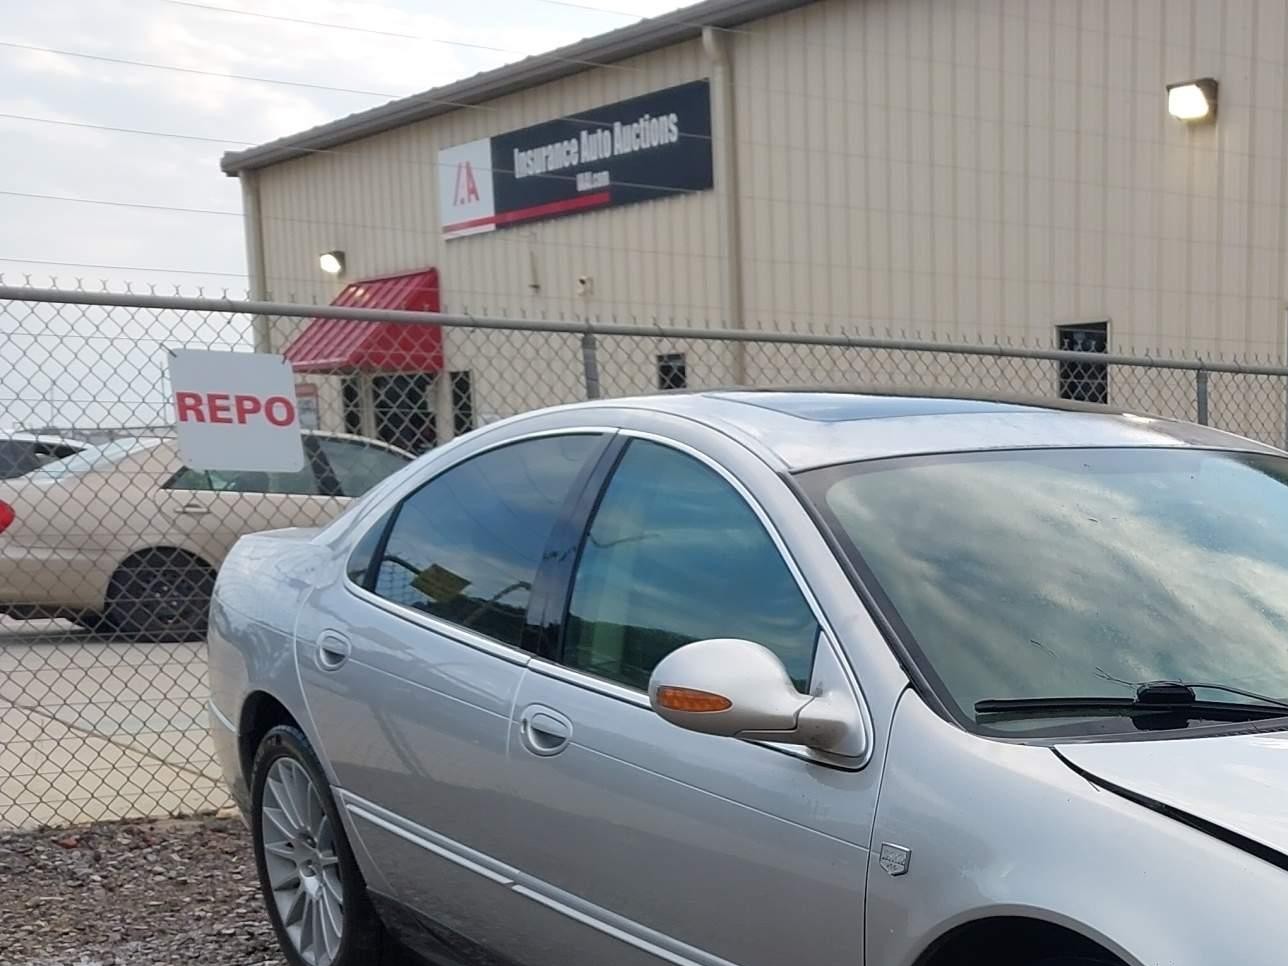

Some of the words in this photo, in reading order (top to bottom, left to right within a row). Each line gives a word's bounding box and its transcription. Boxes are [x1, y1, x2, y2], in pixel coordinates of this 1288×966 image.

[514, 138, 578, 178] Insurance
[580, 130, 611, 163] Auto
[613, 113, 678, 155] Auctions
[176, 392, 295, 426] REPO
